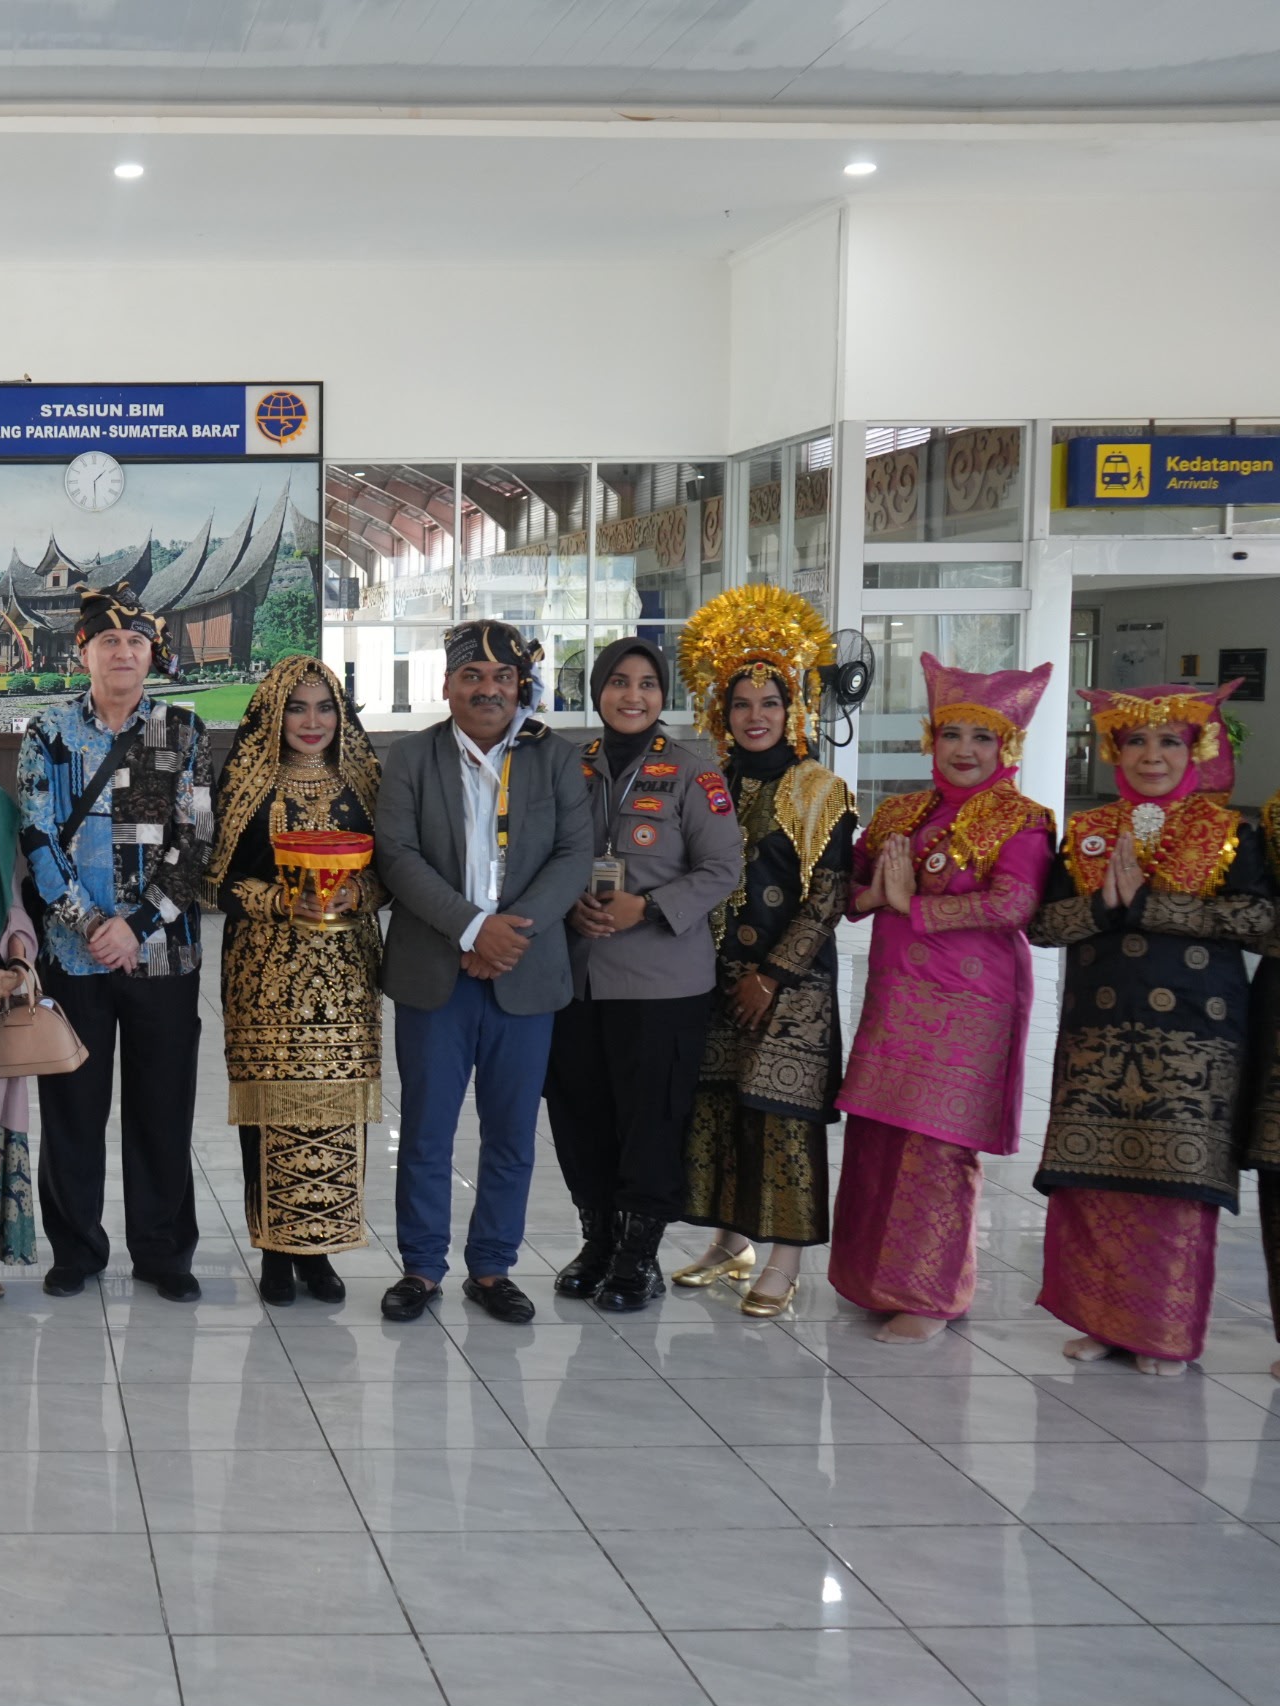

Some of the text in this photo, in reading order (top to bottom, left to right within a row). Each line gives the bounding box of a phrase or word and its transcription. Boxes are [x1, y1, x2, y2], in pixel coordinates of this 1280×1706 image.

[40, 403, 164, 417] STASIUN BIM
[192, 424, 240, 438] BARAT
[1166, 455, 1274, 475] Kedatangan
[1166, 477, 1219, 490] Arrivals
[632, 780, 677, 793] POLRI
